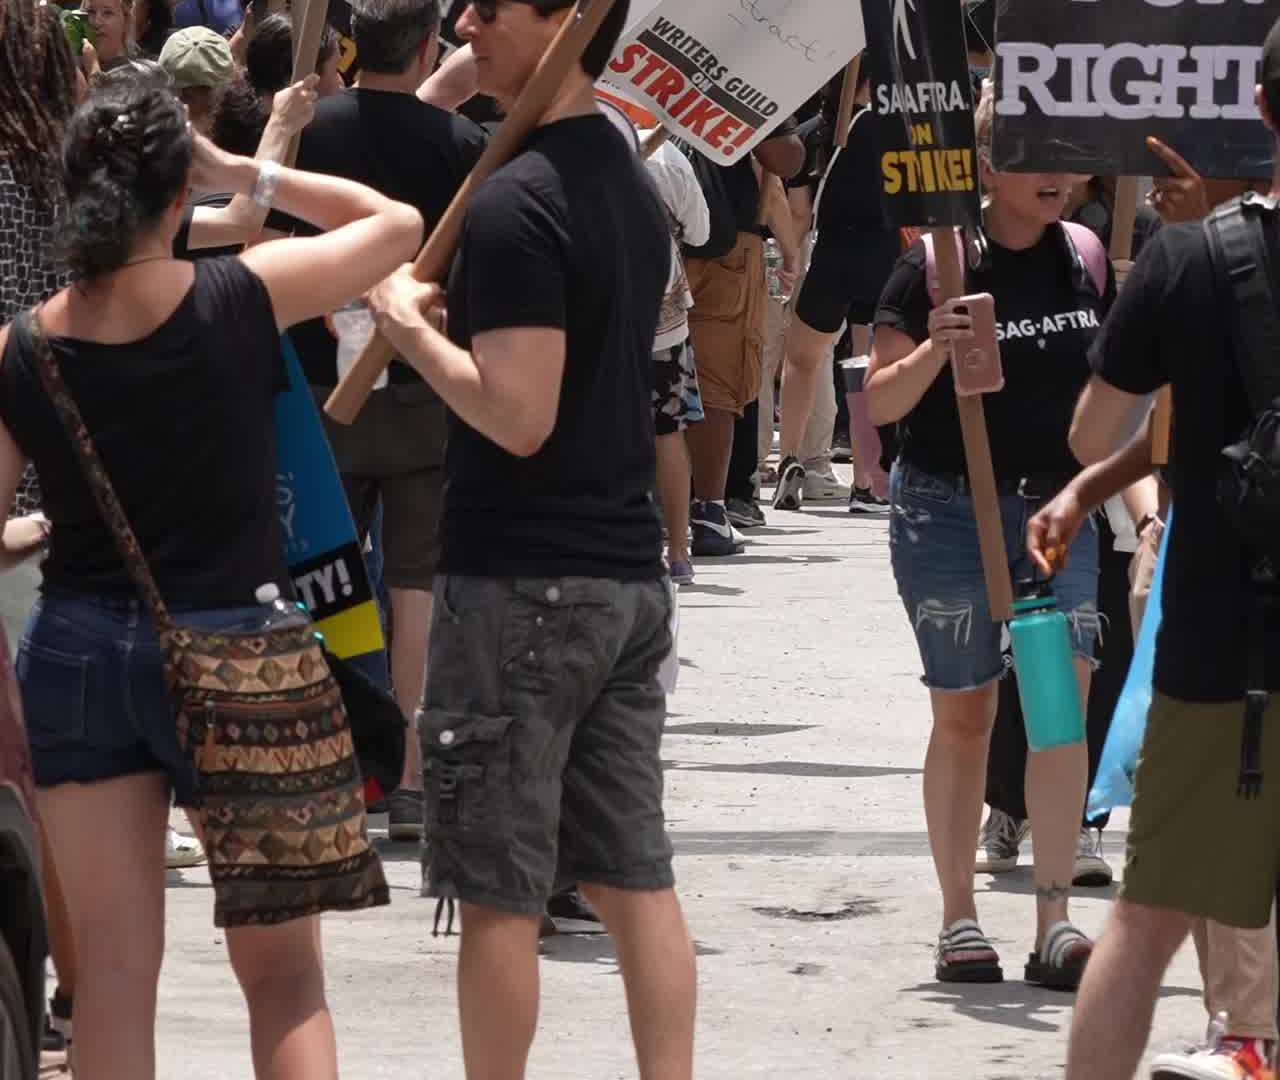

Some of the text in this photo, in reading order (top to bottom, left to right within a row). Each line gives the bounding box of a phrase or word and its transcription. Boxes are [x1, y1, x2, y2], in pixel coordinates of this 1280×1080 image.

[608, 43, 758, 156] STRIKE!
[651, 16, 779, 117] WRITERS GUILD
[691, 72, 714, 92] ON
[995, 41, 1263, 120] RIGHT
